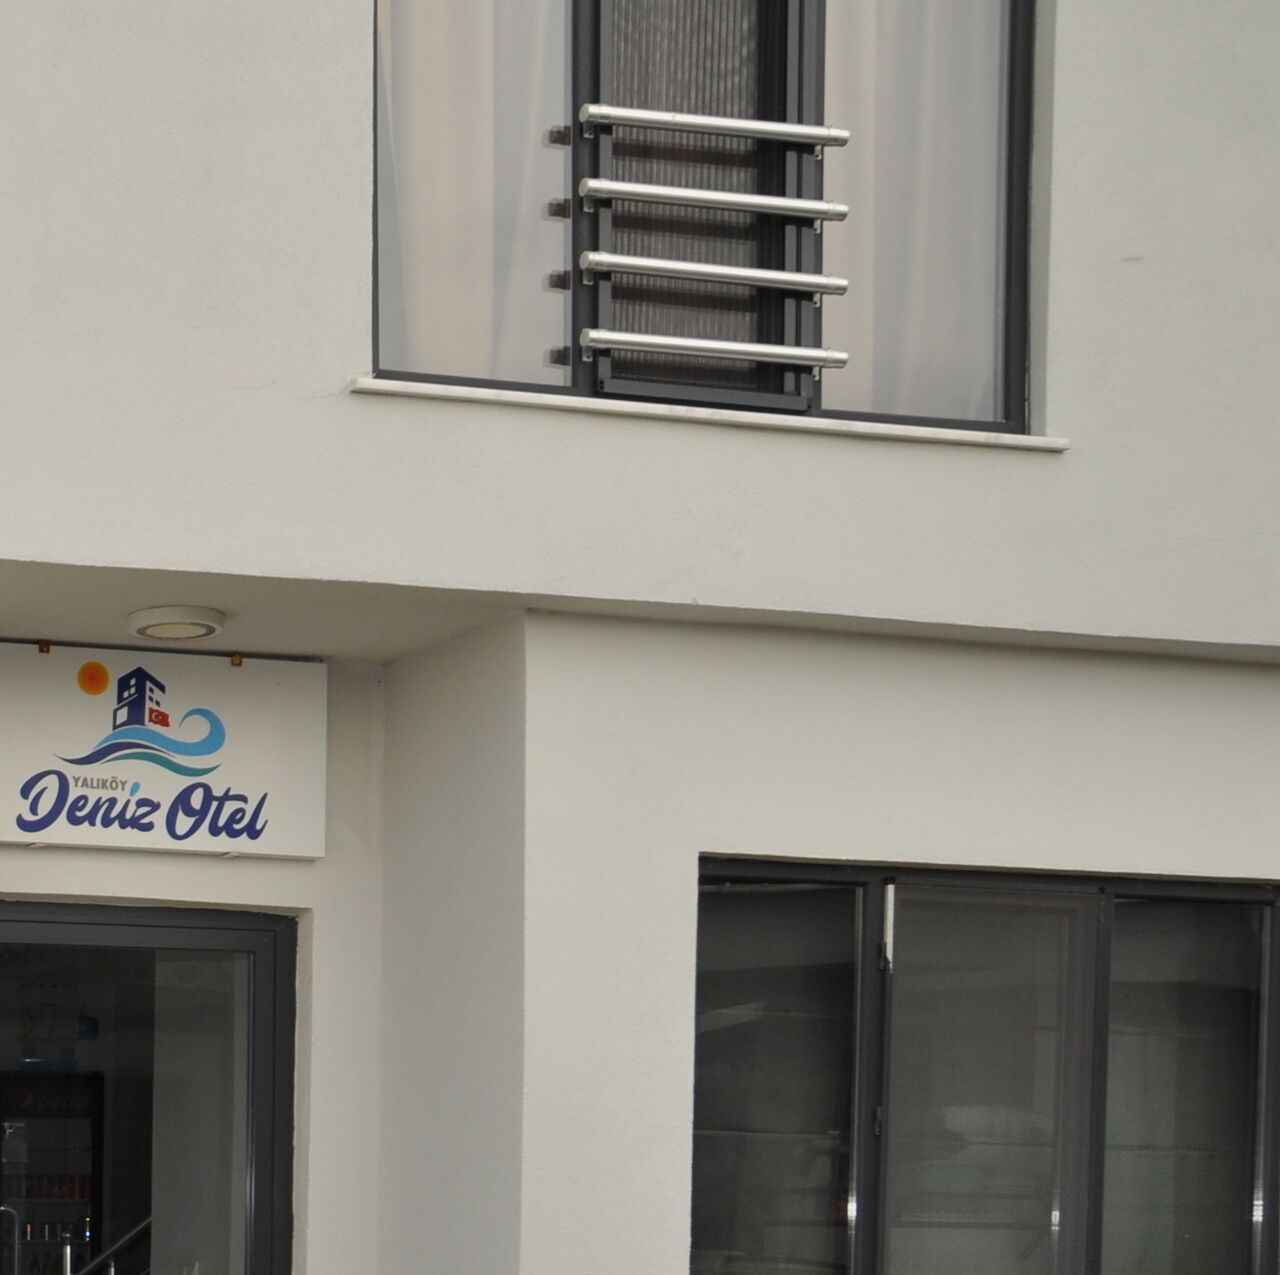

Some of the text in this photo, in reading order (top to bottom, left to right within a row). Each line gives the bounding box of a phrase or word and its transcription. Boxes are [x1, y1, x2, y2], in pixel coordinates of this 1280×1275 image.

[15, 769, 269, 841] Deniz Otel
[72, 775, 128, 791] YALIKÖY
